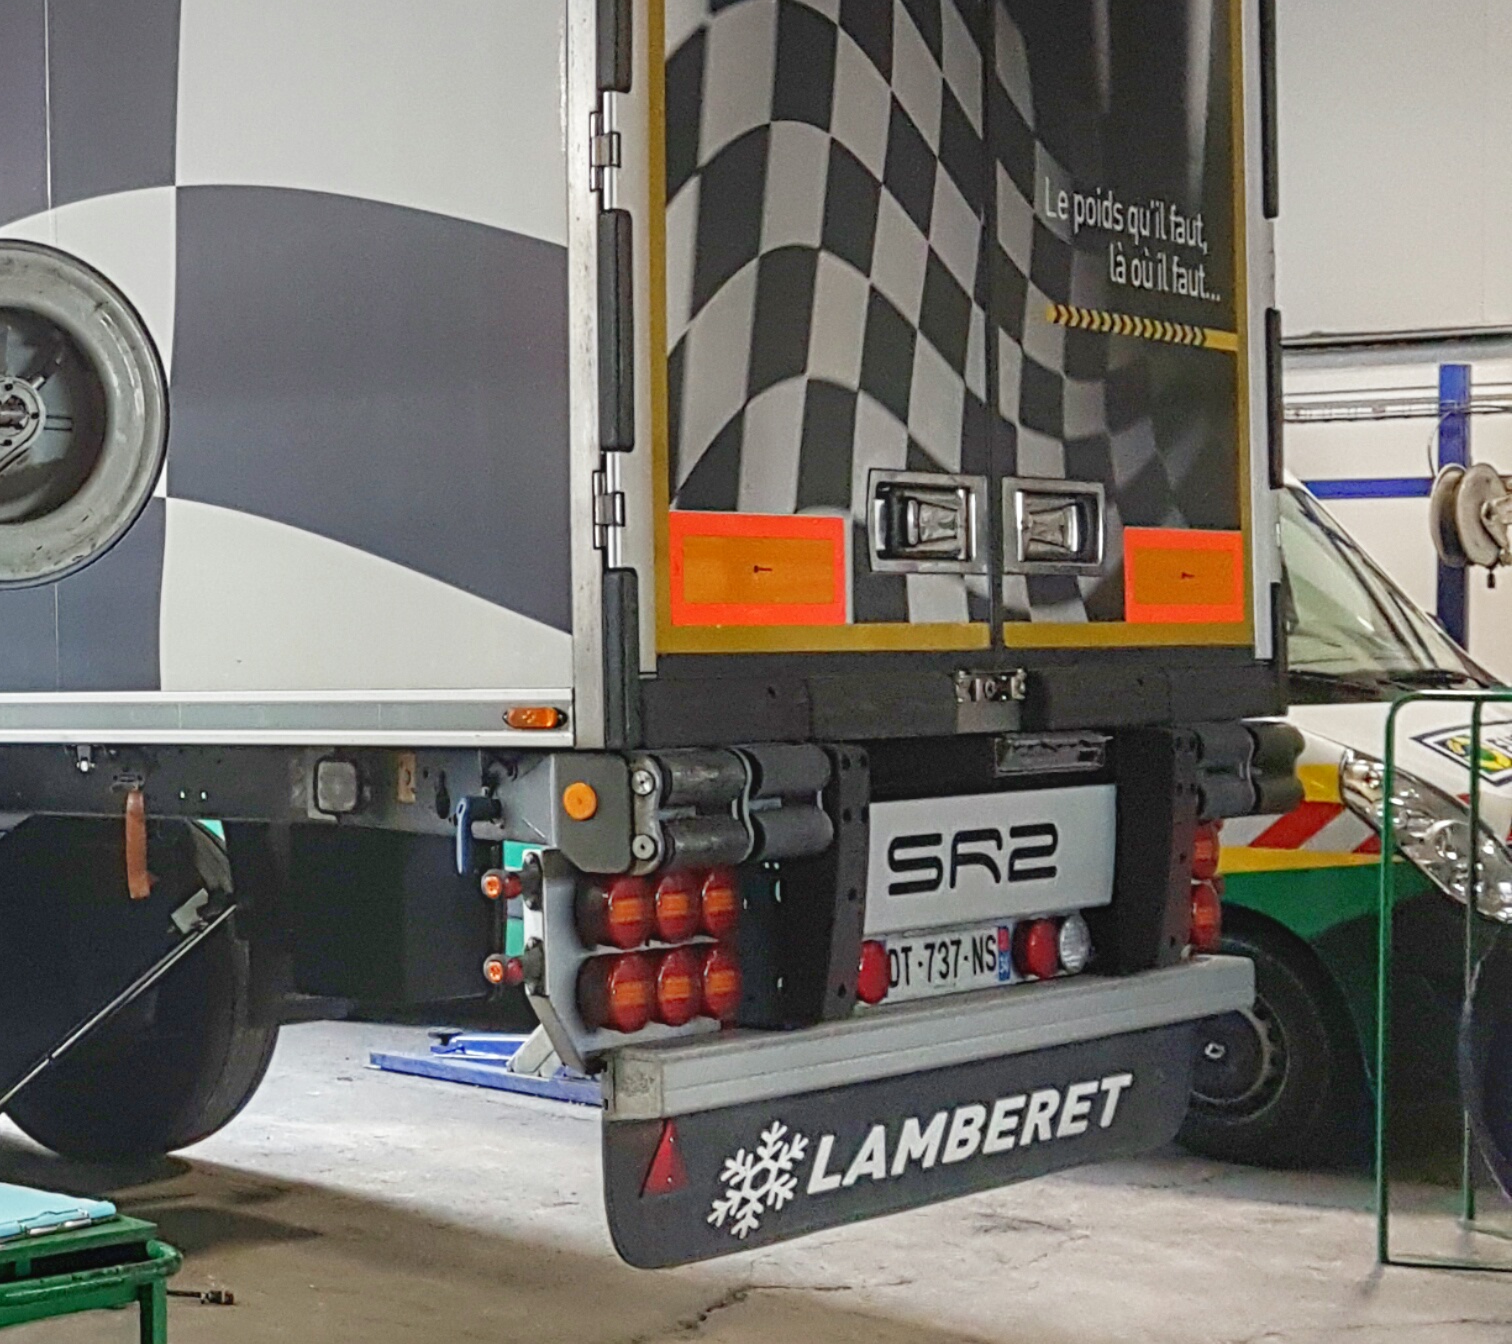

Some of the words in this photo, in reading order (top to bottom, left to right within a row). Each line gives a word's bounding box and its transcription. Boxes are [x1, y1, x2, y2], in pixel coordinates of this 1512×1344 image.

[1045, 176, 1069, 220] Le
[1073, 187, 1124, 234] poids
[1128, 199, 1167, 245] qu'il
[1170, 204, 1208, 255] faut,
[1109, 241, 1127, 284] là
[1131, 247, 1154, 289] où
[1157, 252, 1169, 292] il
[1172, 256, 1221, 302] faut...
[888, 823, 1058, 896] SR2
[806, 1073, 1134, 1195] LAMBERET
